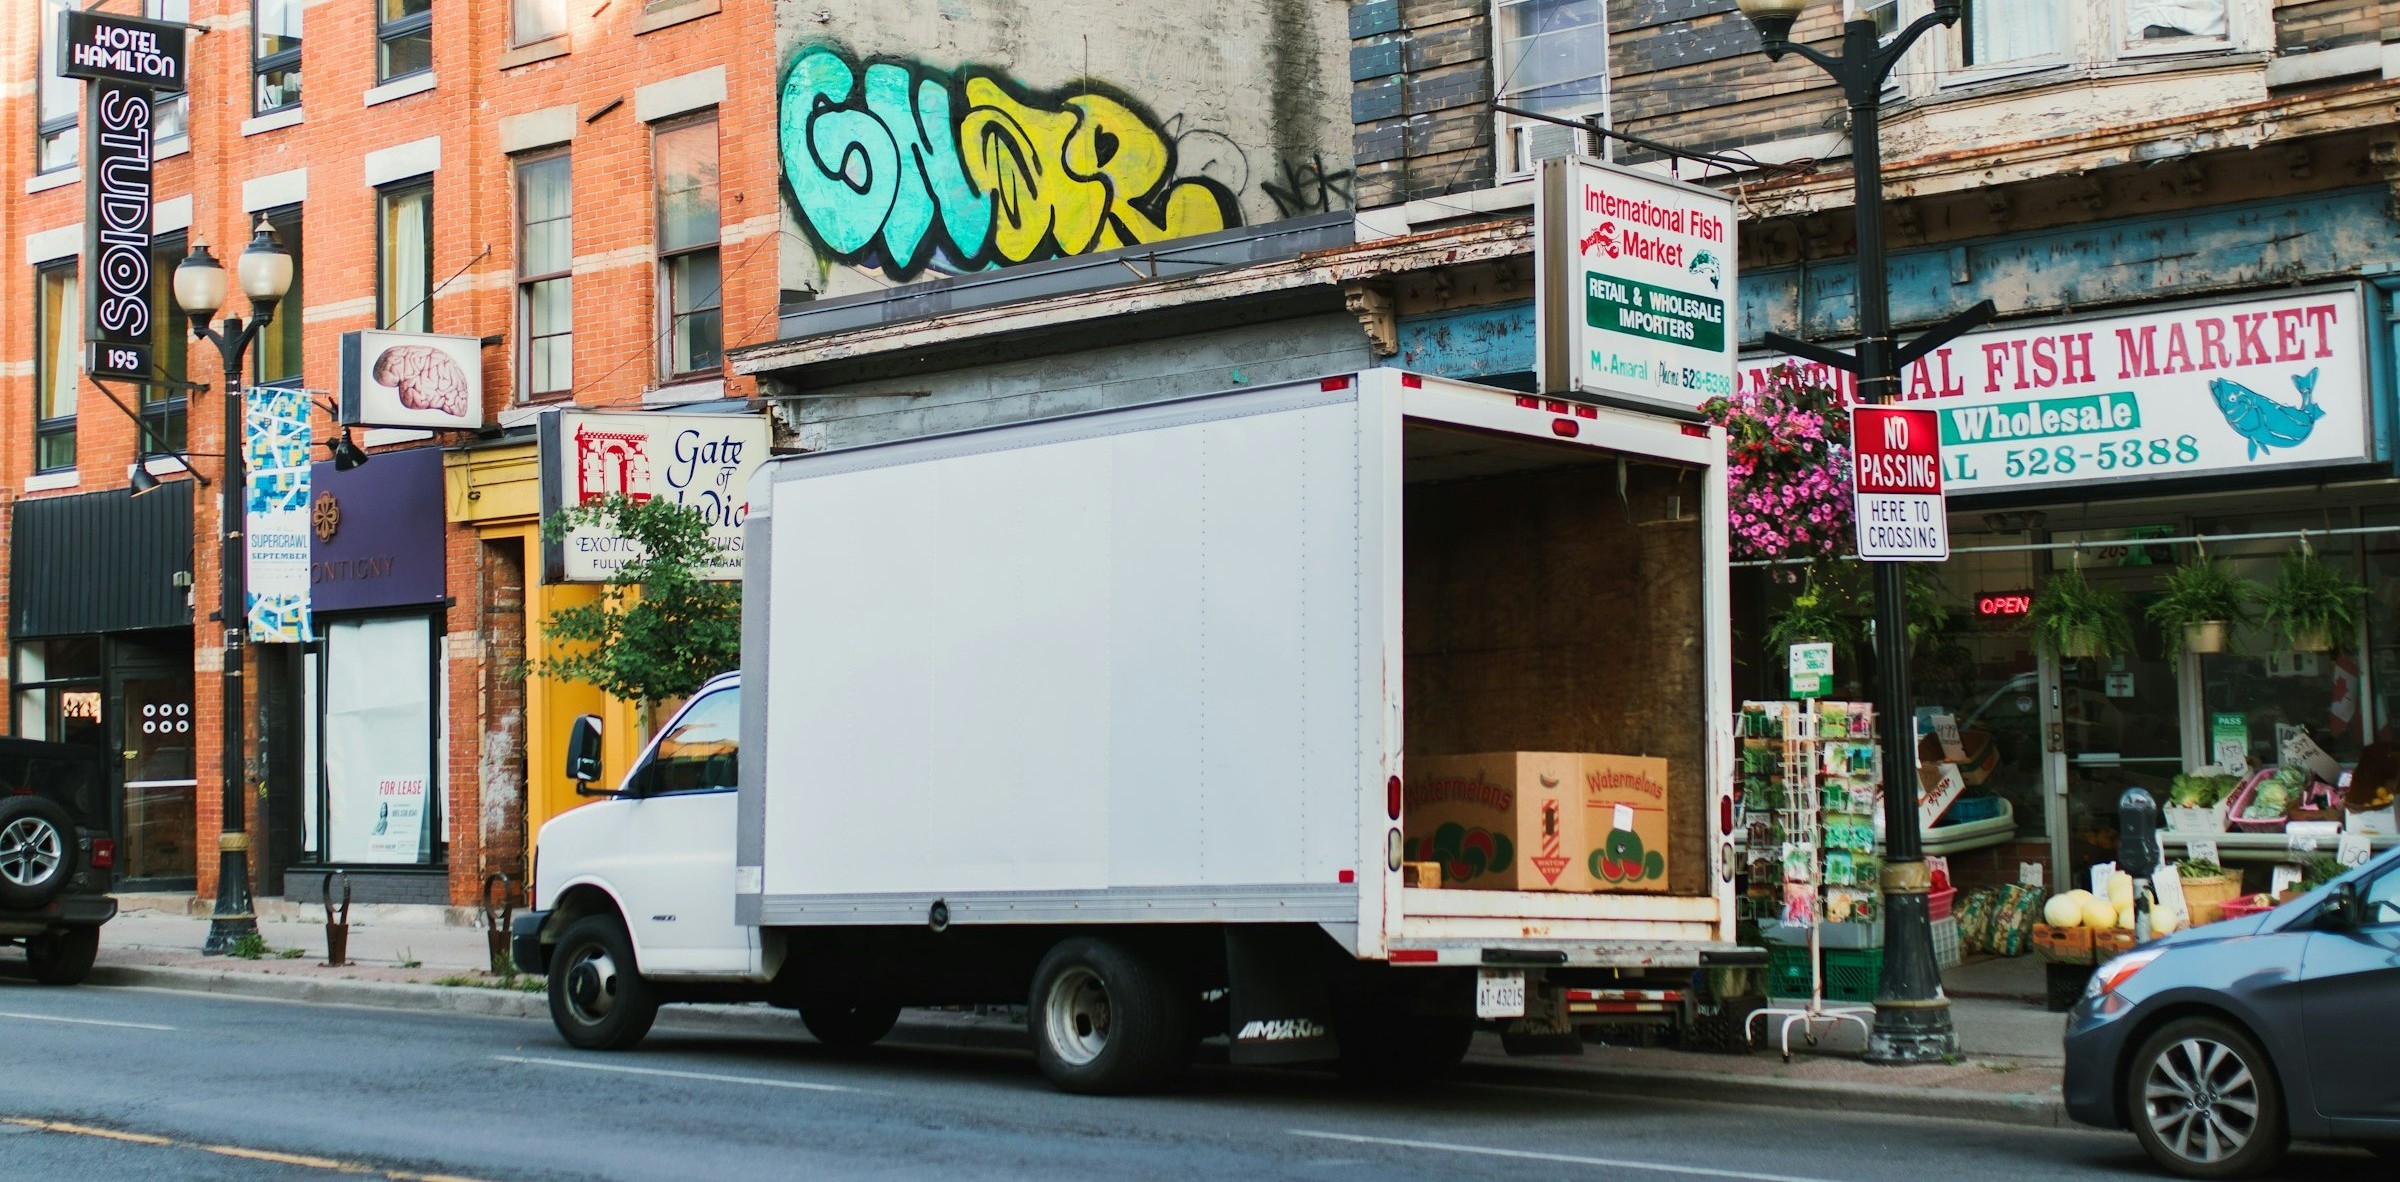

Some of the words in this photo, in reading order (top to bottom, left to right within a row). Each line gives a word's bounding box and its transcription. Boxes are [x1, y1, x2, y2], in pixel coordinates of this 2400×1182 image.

[95, 25, 161, 55] HOTEL
[75, 43, 175, 78] HAMILTON
[101, 89, 149, 337] STUDIOS
[1585, 183, 1685, 234] International
[1690, 210, 1723, 243] Fish
[1622, 229, 1683, 268] Market
[1589, 277, 1629, 305] RETAIL
[1632, 286, 1643, 307] &
[1649, 291, 1722, 324] WHOLESALE
[1619, 307, 1695, 341] IMPORTERS
[107, 349, 139, 370] 195
[1982, 332, 2096, 393] FISH
[2115, 304, 2338, 380] MARKET
[1610, 354, 1648, 381] Amaral
[1682, 367, 1731, 395] 528-5388
[1883, 416, 1909, 451] NO
[1952, 395, 2132, 441] Wholesale
[666, 429, 747, 488] Gate
[1860, 454, 1936, 489] PASSING
[2005, 434, 2200, 478] 528-5388
[716, 466, 737, 495] of
[1871, 501, 1907, 523] HERE
[1915, 501, 1930, 522] TO
[251, 534, 308, 549] SUPERCRAWL
[1869, 526, 1937, 549] CROSSING
[251, 552, 308, 561] SEPTEMBER
[312, 556, 396, 584] ONTIGNY
[1979, 596, 2031, 615] OPEN
[2218, 717, 2242, 726] PASS
[379, 781, 396, 796] FOR
[397, 780, 422, 796] LEASE
[1404, 768, 1515, 813] Watermelons
[1586, 767, 1664, 800] Watermelons
[1537, 859, 1565, 867] WATCH
[2337, 842, 2368, 866] 150
[1542, 867, 1561, 875] STEP
